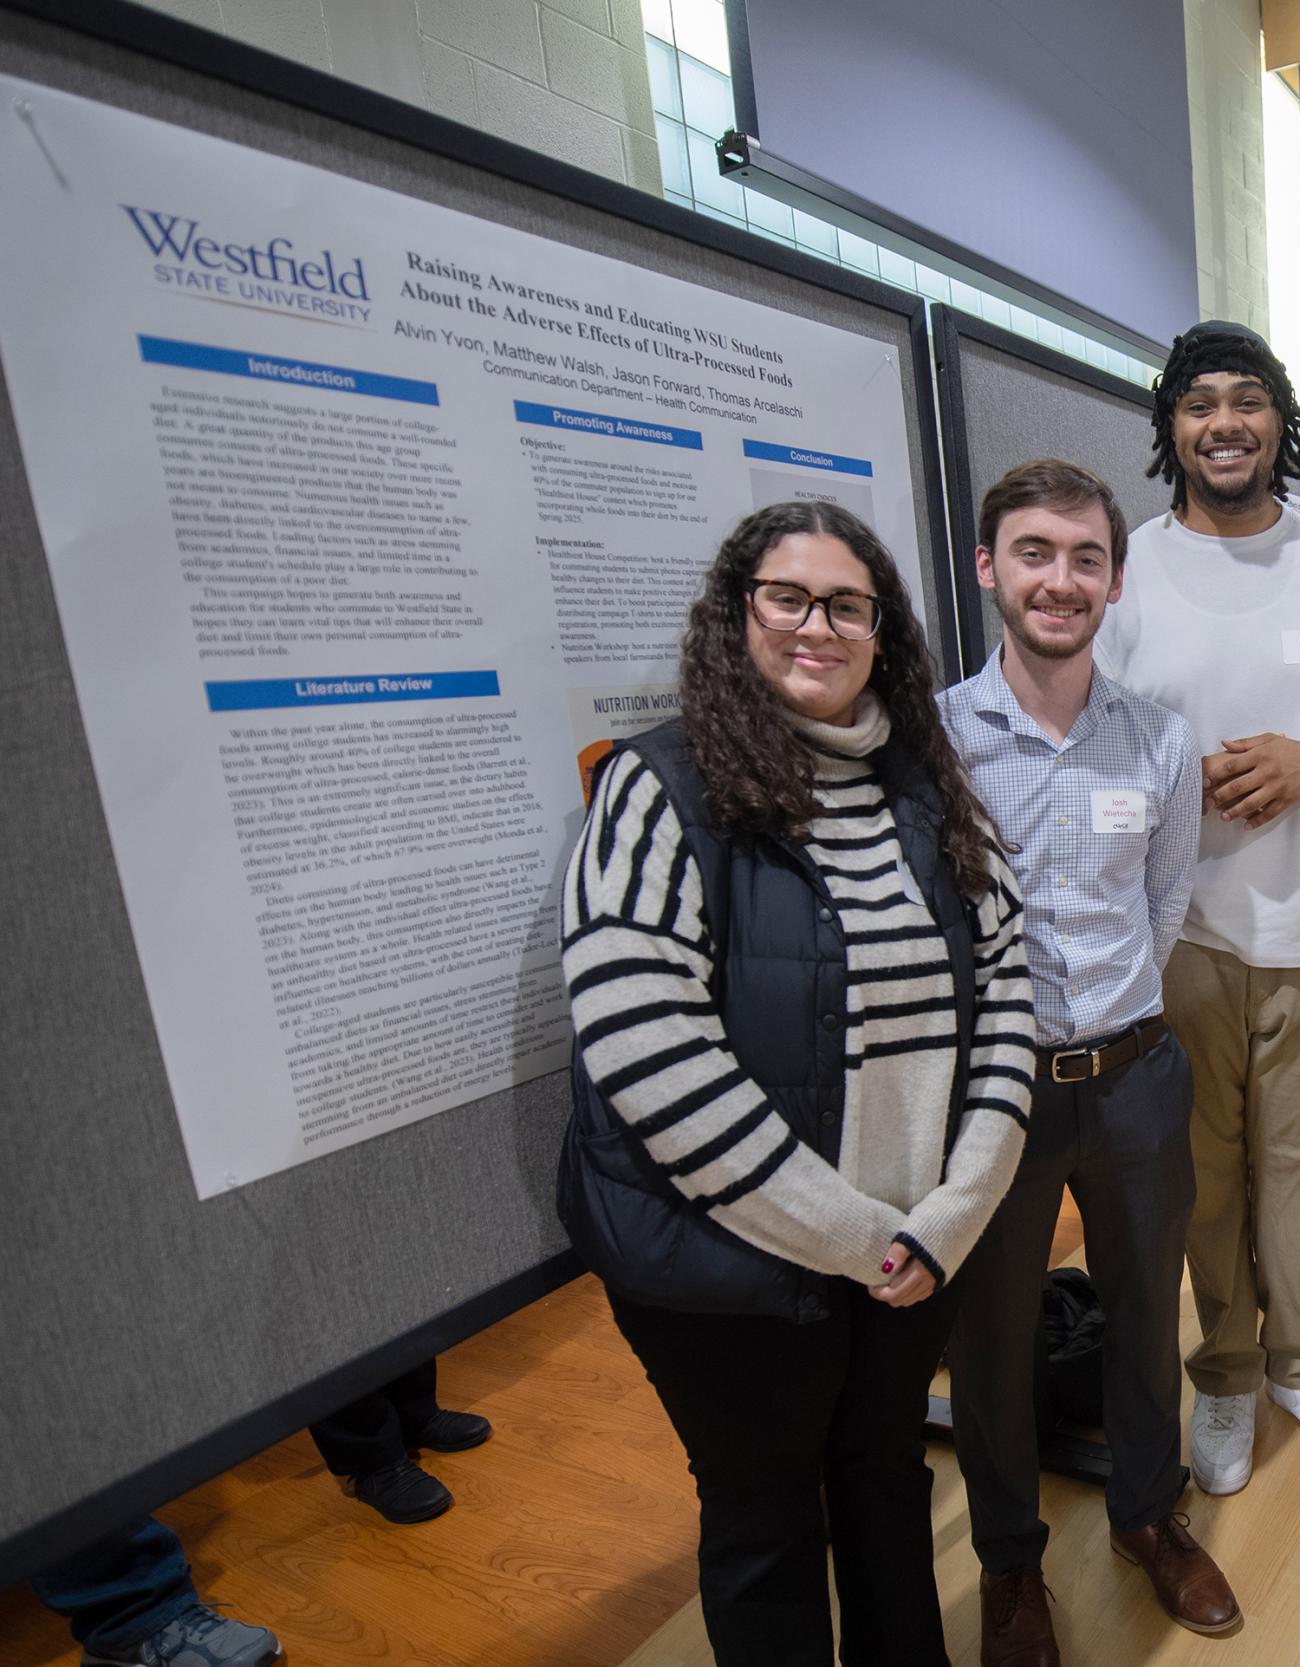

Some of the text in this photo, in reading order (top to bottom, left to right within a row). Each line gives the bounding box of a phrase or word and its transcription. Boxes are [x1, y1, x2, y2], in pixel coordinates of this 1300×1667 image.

[118, 203, 370, 300] Westfield
[154, 264, 370, 322] STATE UNIVERSITY
[407, 253, 782, 363] Raising Awareness and Educating WSU Students
[400, 283, 792, 385] About the Adverse Effects of Ultra-Processed Foods
[248, 357, 355, 386] Introduction
[393, 320, 802, 417] Alvin Yvon, Matthew Walsh, Jason Forward, Thomas Arcelaschi
[482, 359, 577, 388] Communication
[580, 378, 643, 401] Department
[654, 392, 686, 409] Health
[688, 398, 757, 423] Communication
[552, 410, 672, 440] Promoting Awareness
[519, 435, 565, 450] Objective:
[789, 448, 833, 466] Conclusion
[535, 534, 604, 548] Implementation:
[295, 676, 432, 695] Literature Review
[594, 696, 650, 713] NUTRITION
